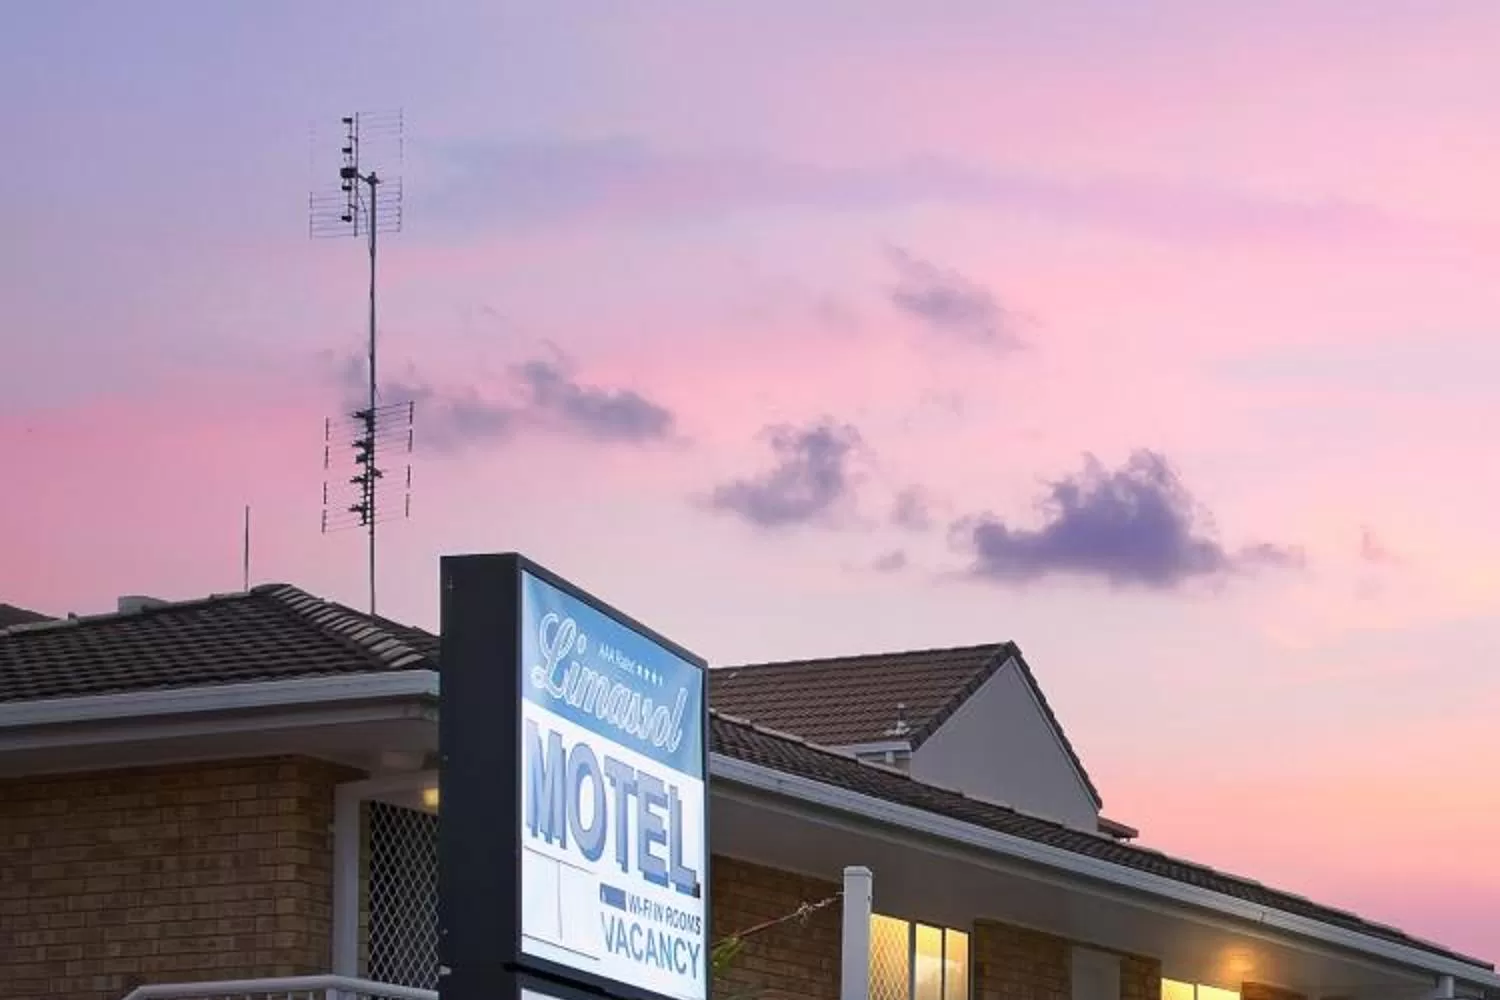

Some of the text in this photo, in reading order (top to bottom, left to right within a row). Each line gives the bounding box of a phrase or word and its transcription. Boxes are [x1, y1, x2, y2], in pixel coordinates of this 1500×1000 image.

[531, 610, 689, 754] Limassol
[526, 719, 700, 898] MOTEL
[600, 911, 701, 980] VACANCY
[665, 906, 701, 936] ROOMS
